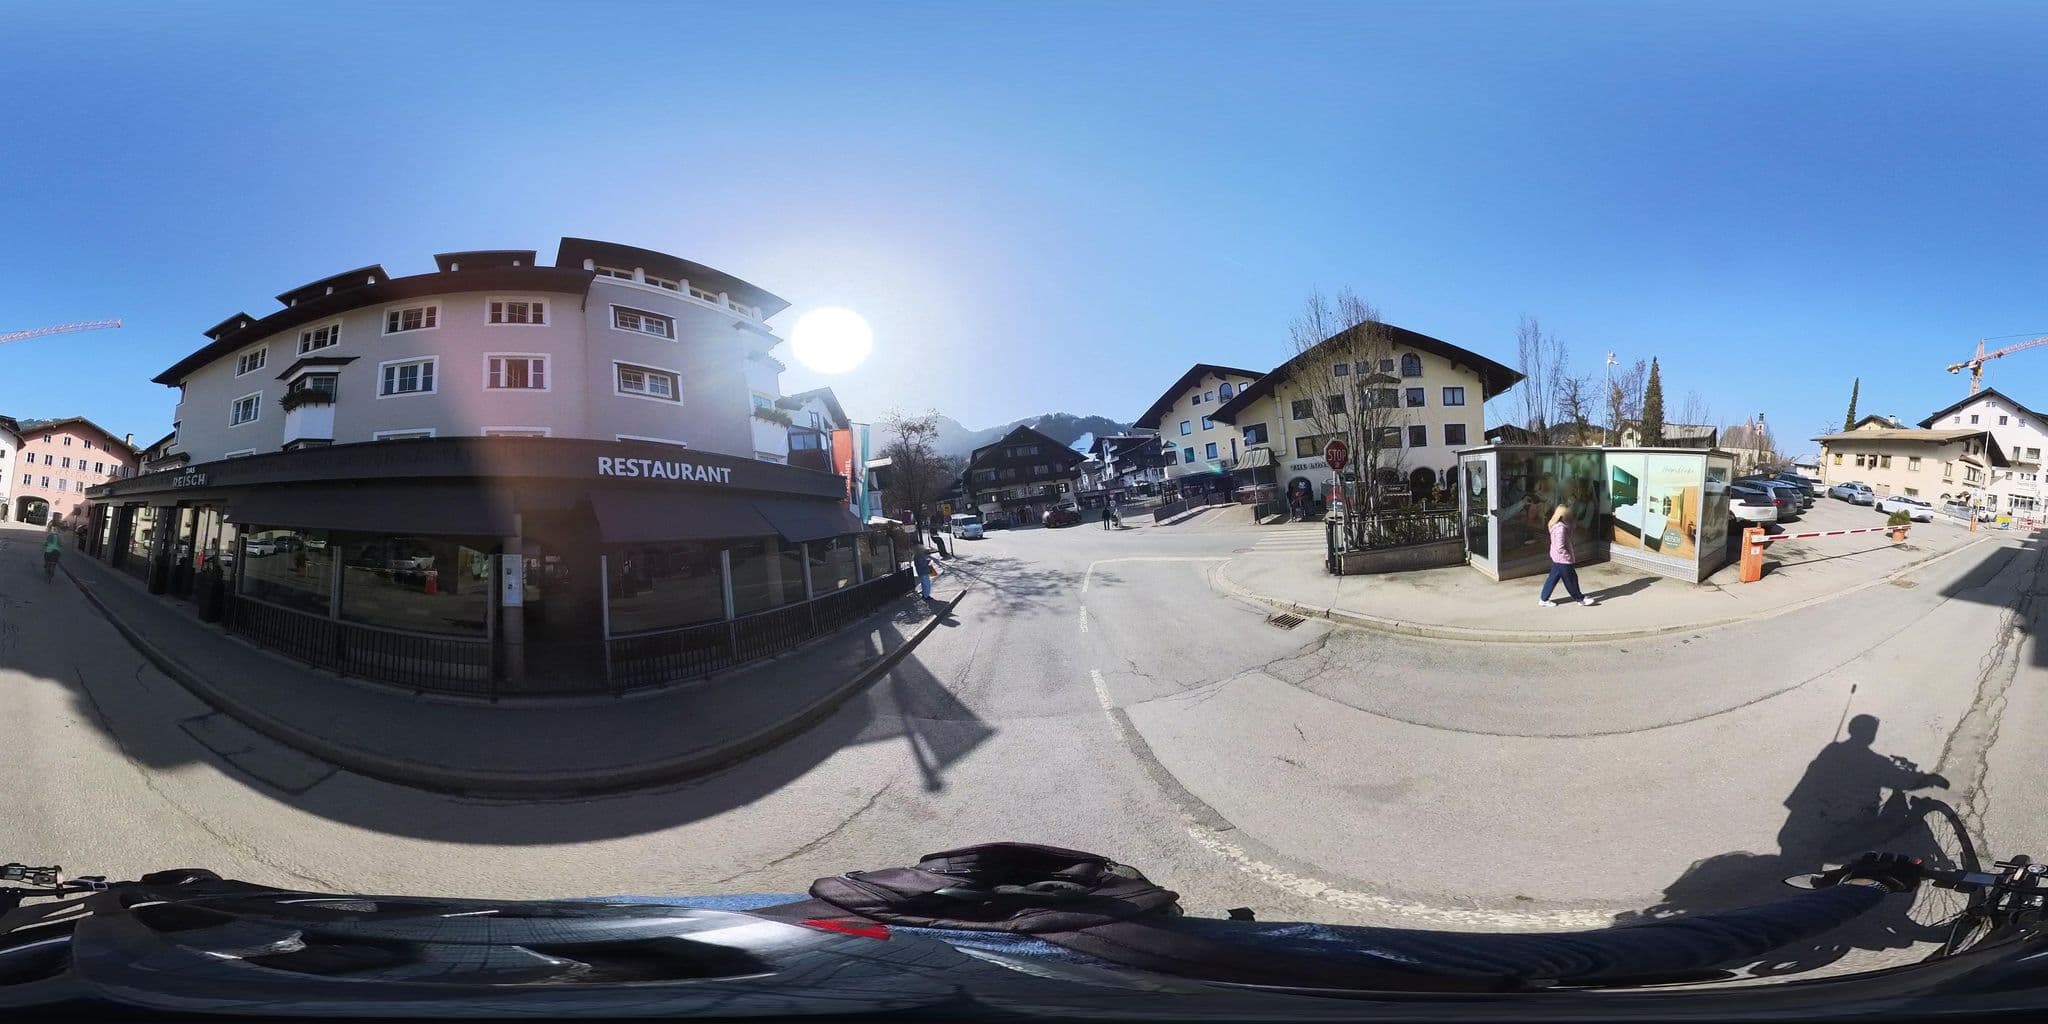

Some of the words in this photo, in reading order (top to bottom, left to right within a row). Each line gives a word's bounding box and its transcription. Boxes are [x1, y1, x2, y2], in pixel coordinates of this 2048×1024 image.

[1327, 449, 1346, 461] STOP
[598, 456, 731, 483] RESTAURANT
[173, 473, 206, 487] REISCH
